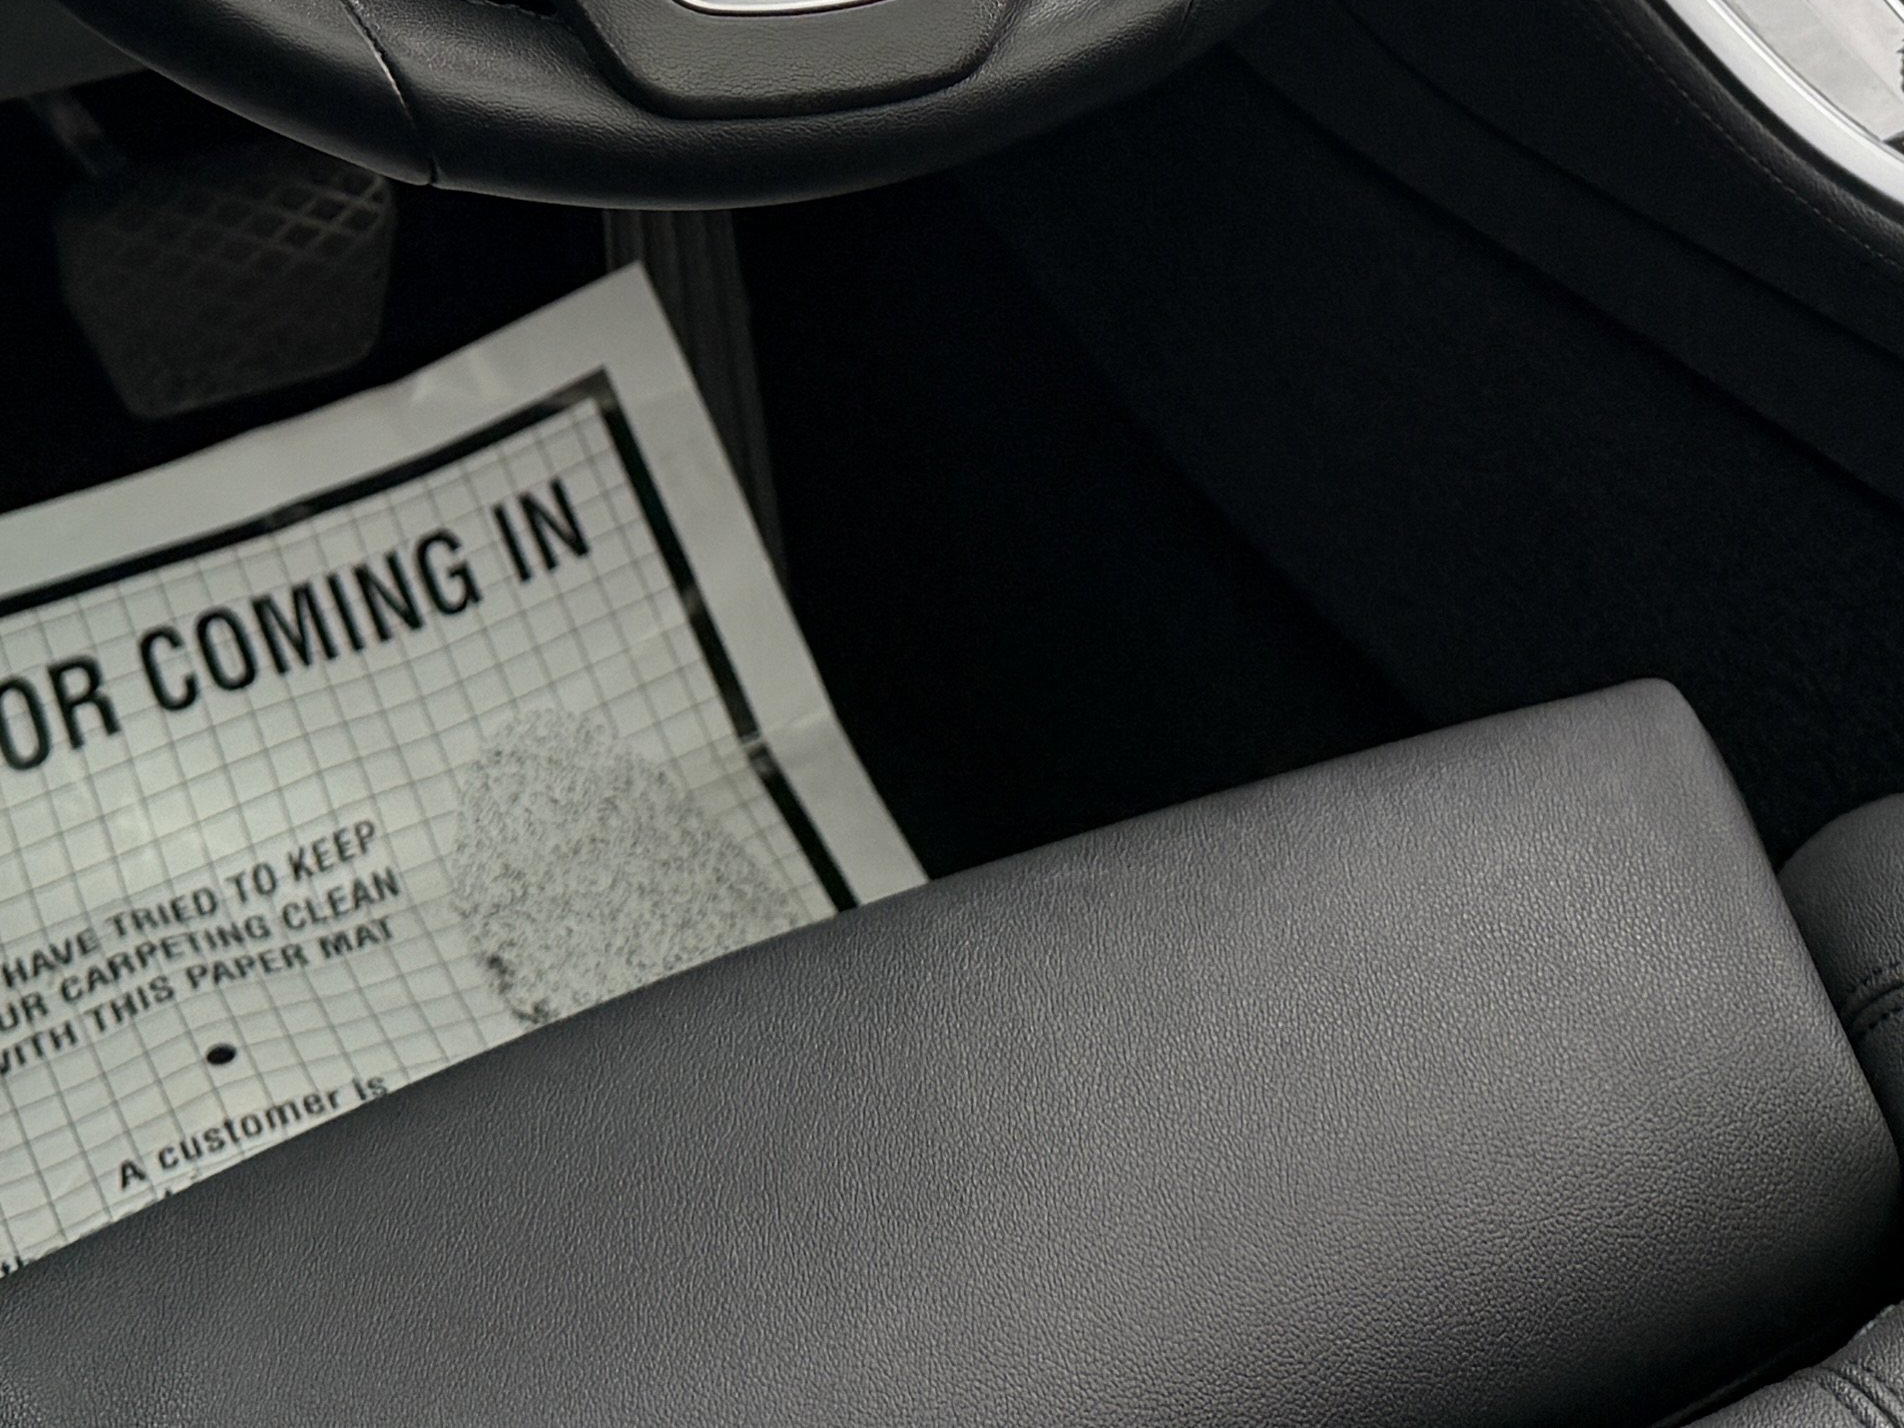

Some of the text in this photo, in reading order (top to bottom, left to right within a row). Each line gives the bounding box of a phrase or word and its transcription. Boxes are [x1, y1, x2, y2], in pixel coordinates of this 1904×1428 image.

[138, 528, 485, 714] COMING
[491, 478, 591, 584] IN
[1, 927, 99, 990] HAVE
[106, 887, 219, 941] TRIED
[225, 864, 279, 906] TO
[287, 819, 377, 882] KEEP
[59, 914, 272, 1003] CARPETING
[281, 867, 401, 930] CLEAN
[83, 979, 176, 1036] THIS
[184, 946, 310, 991] PAPER
[318, 915, 395, 960] MAT
[118, 1159, 149, 1191] A
[157, 1089, 343, 1171] customer
